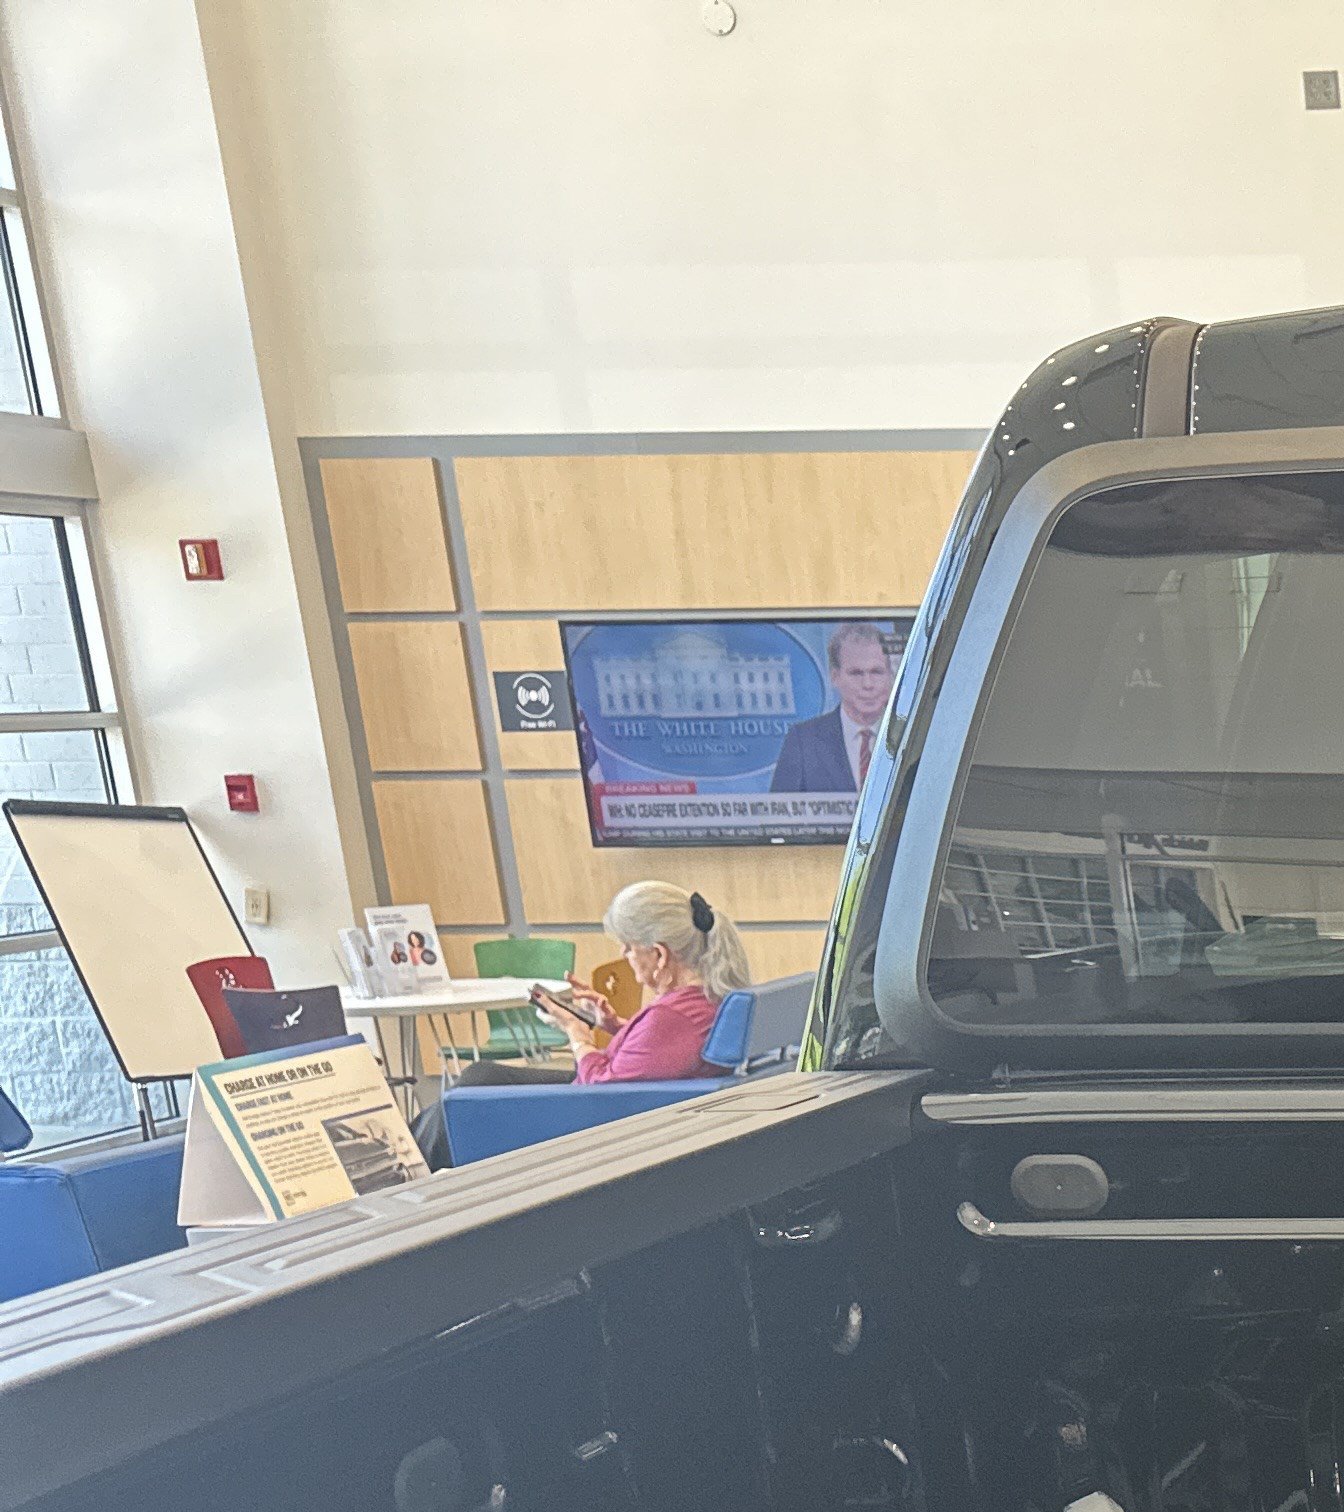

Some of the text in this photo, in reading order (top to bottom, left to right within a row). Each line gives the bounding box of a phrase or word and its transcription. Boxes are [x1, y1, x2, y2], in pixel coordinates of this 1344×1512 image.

[612, 720, 647, 737] THE
[657, 720, 718, 738] WHITE
[662, 741, 749, 755] WASHINGTON
[605, 783, 690, 794] BREAKING NEWS
[625, 801, 638, 818] NO
[721, 800, 731, 818] SO
[731, 800, 748, 817] FAR
[750, 800, 769, 817] WITH
[223, 1060, 334, 1095] CHARGE AT HOME OR ON THE GO
